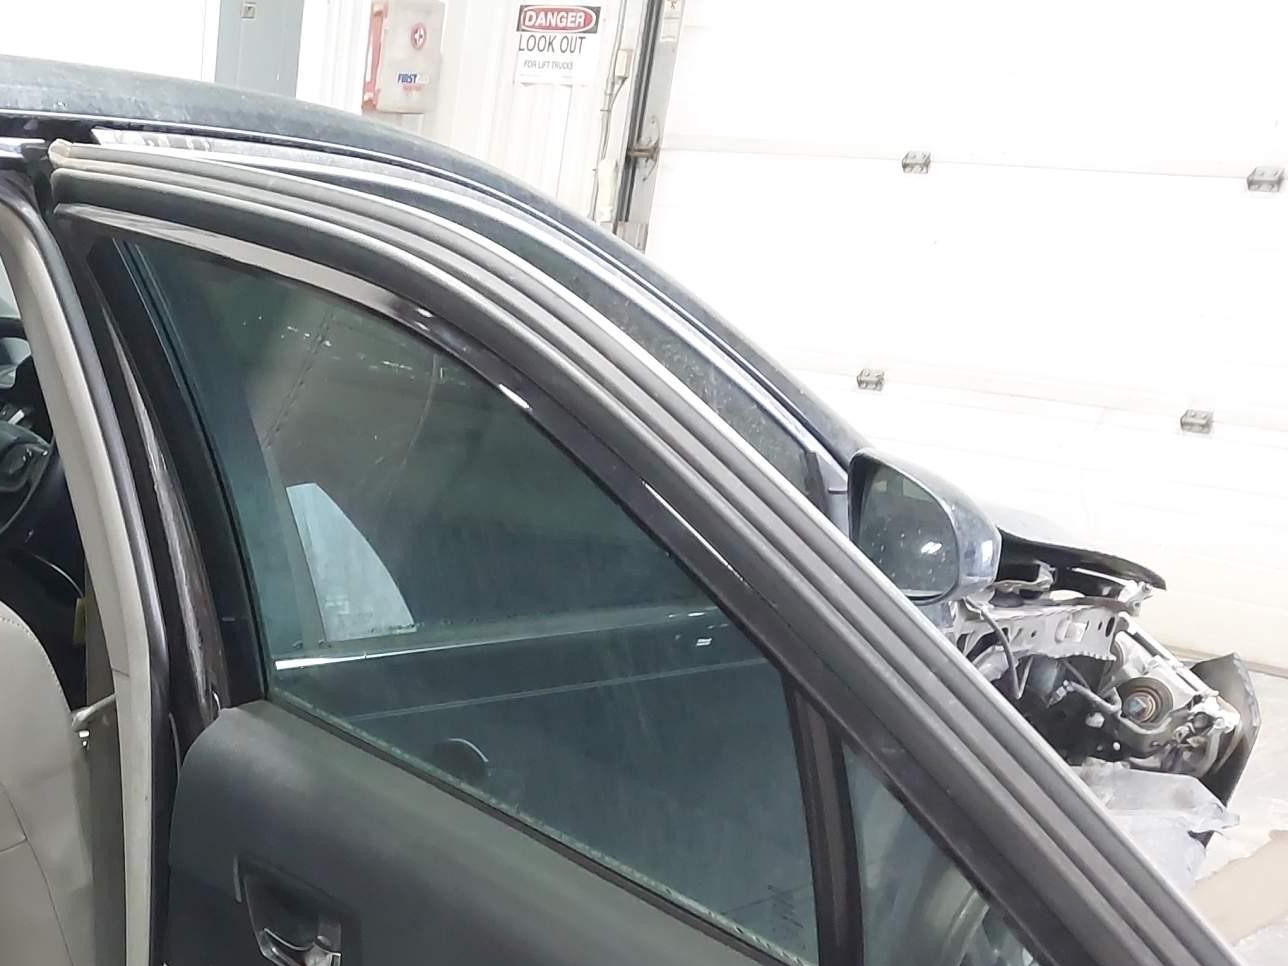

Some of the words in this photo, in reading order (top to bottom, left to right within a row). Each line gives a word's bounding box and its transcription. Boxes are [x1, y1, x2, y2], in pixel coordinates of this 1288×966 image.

[524, 10, 585, 28] DANGER
[518, 34, 557, 53] LOOK
[560, 35, 586, 54] OUT
[523, 60, 536, 69] FOR
